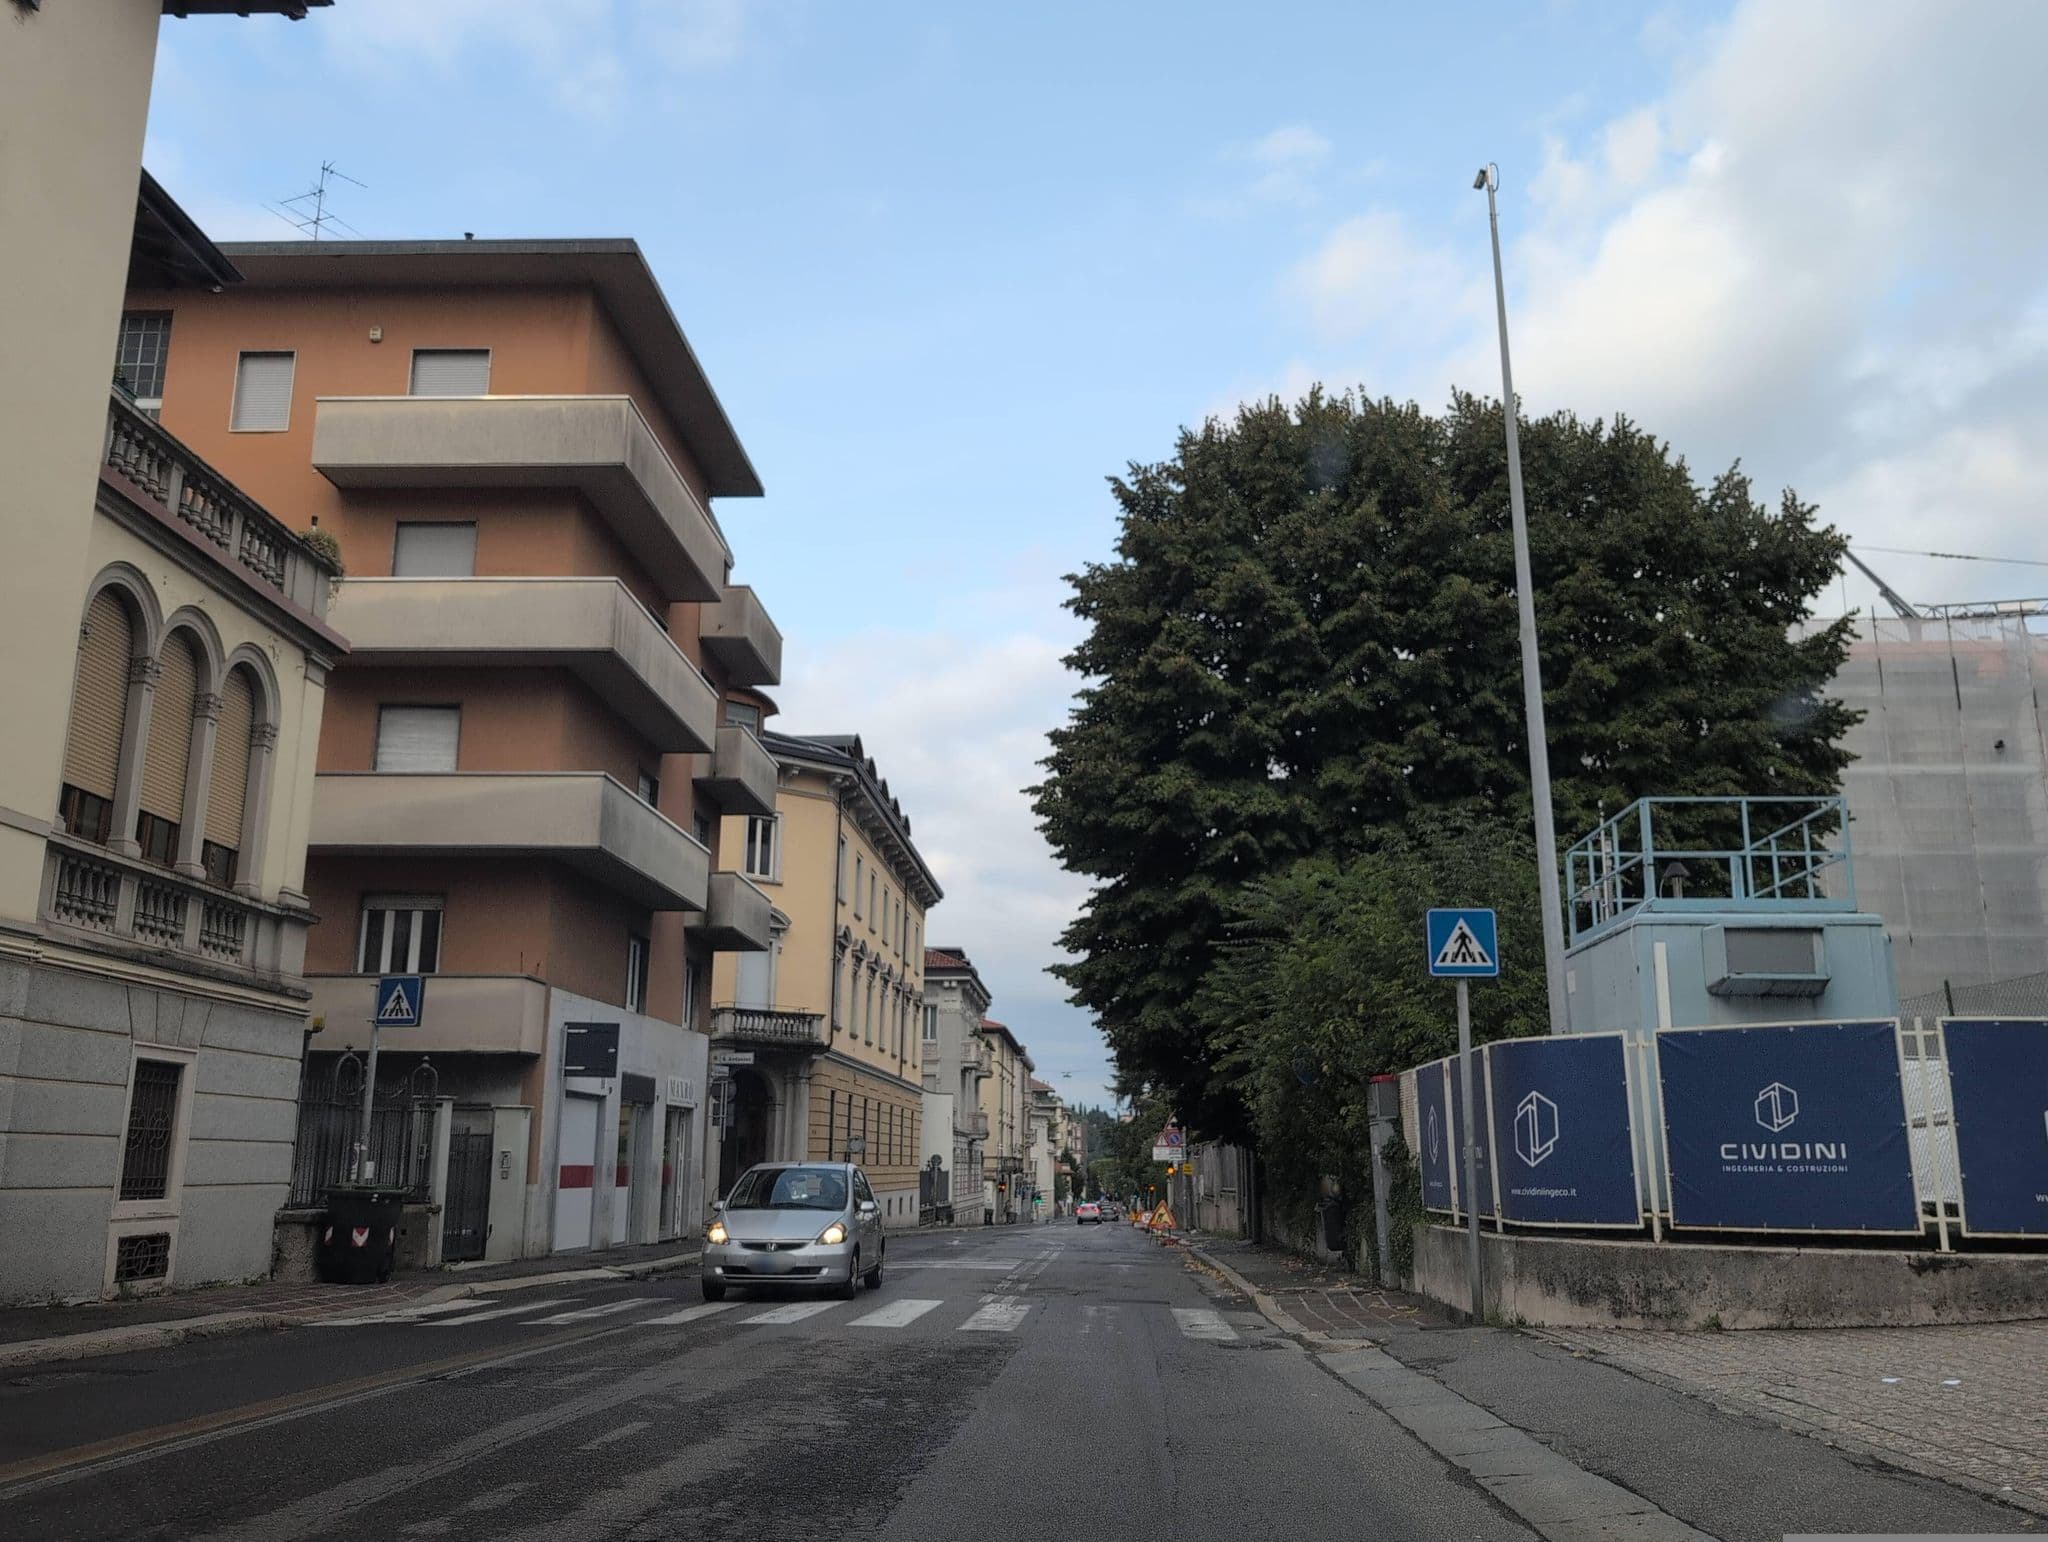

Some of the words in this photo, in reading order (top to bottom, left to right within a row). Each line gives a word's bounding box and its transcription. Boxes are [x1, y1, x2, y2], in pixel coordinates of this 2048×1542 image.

[1720, 1143, 1848, 1160] CIVIDINI
[1722, 1165, 1774, 1173] INGEGNERIA
[1777, 1165, 1783, 1173] &
[1786, 1165, 1849, 1173] COSTRUZIONI
